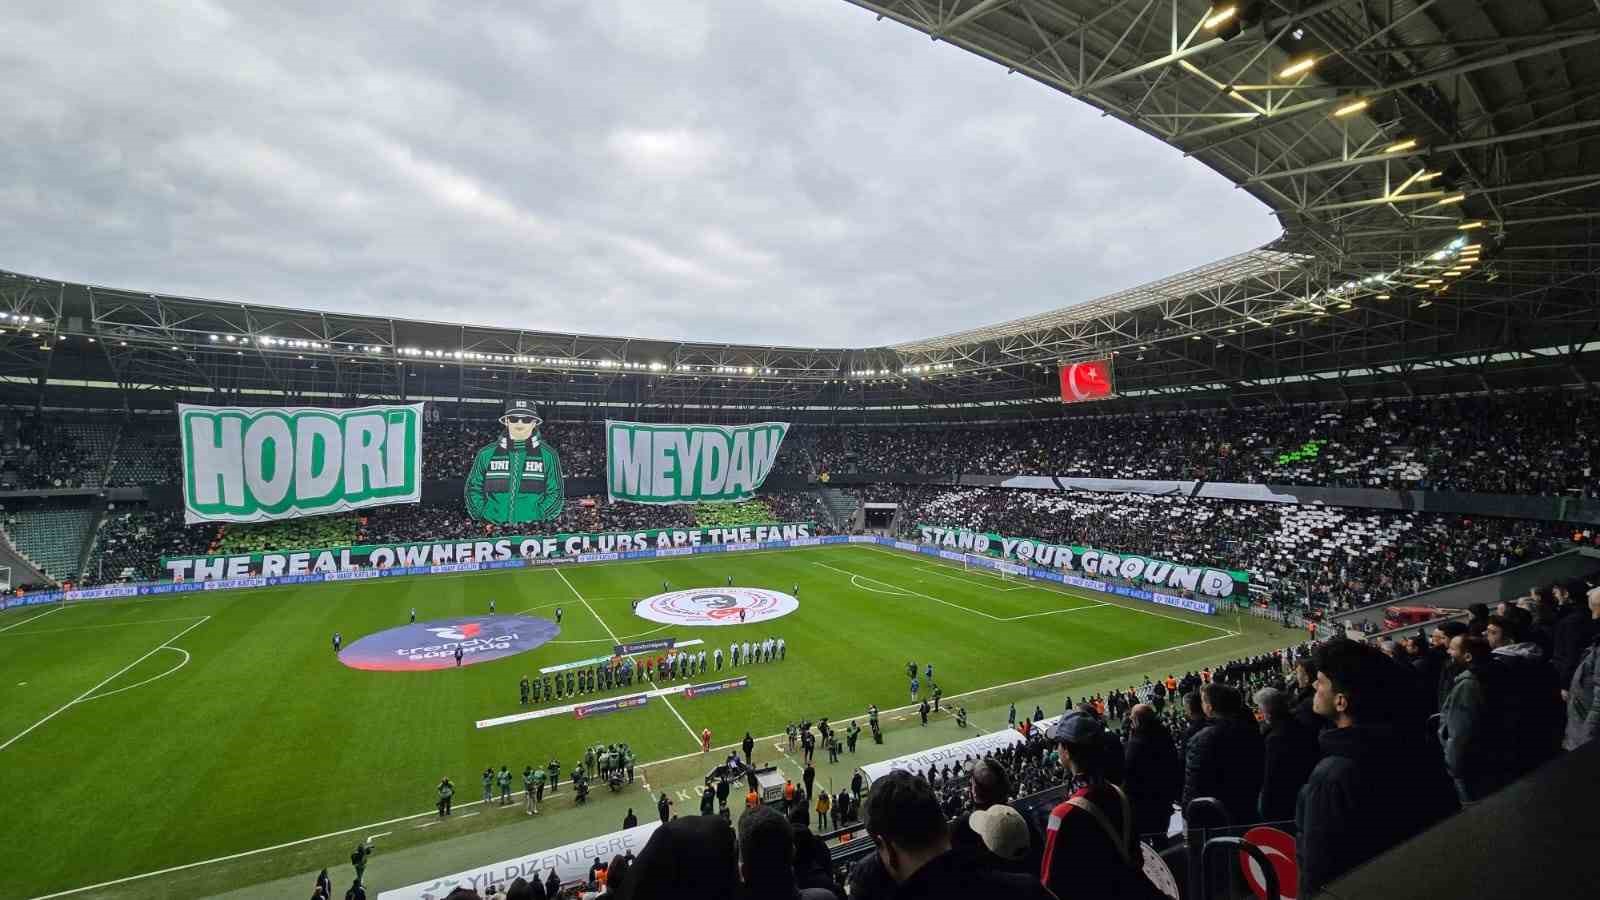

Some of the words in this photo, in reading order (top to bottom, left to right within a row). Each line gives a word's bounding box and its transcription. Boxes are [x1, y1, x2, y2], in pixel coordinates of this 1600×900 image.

[490, 460, 510, 471] UNI
[525, 461, 543, 472] HM
[612, 428, 780, 497] MEYDAN
[166, 556, 250, 584] THE
[261, 549, 359, 577] REAL
[369, 540, 511, 568] OWNERS
[519, 538, 558, 559] OF
[565, 532, 647, 554] CLUBS
[656, 530, 700, 548] ARE
[708, 527, 751, 545] THE
[755, 523, 810, 543] FANS
[920, 527, 990, 552] STAND
[1001, 537, 1074, 570] YOUR
[1081, 550, 1234, 597] GROUND
[397, 634, 520, 656] trendyol
